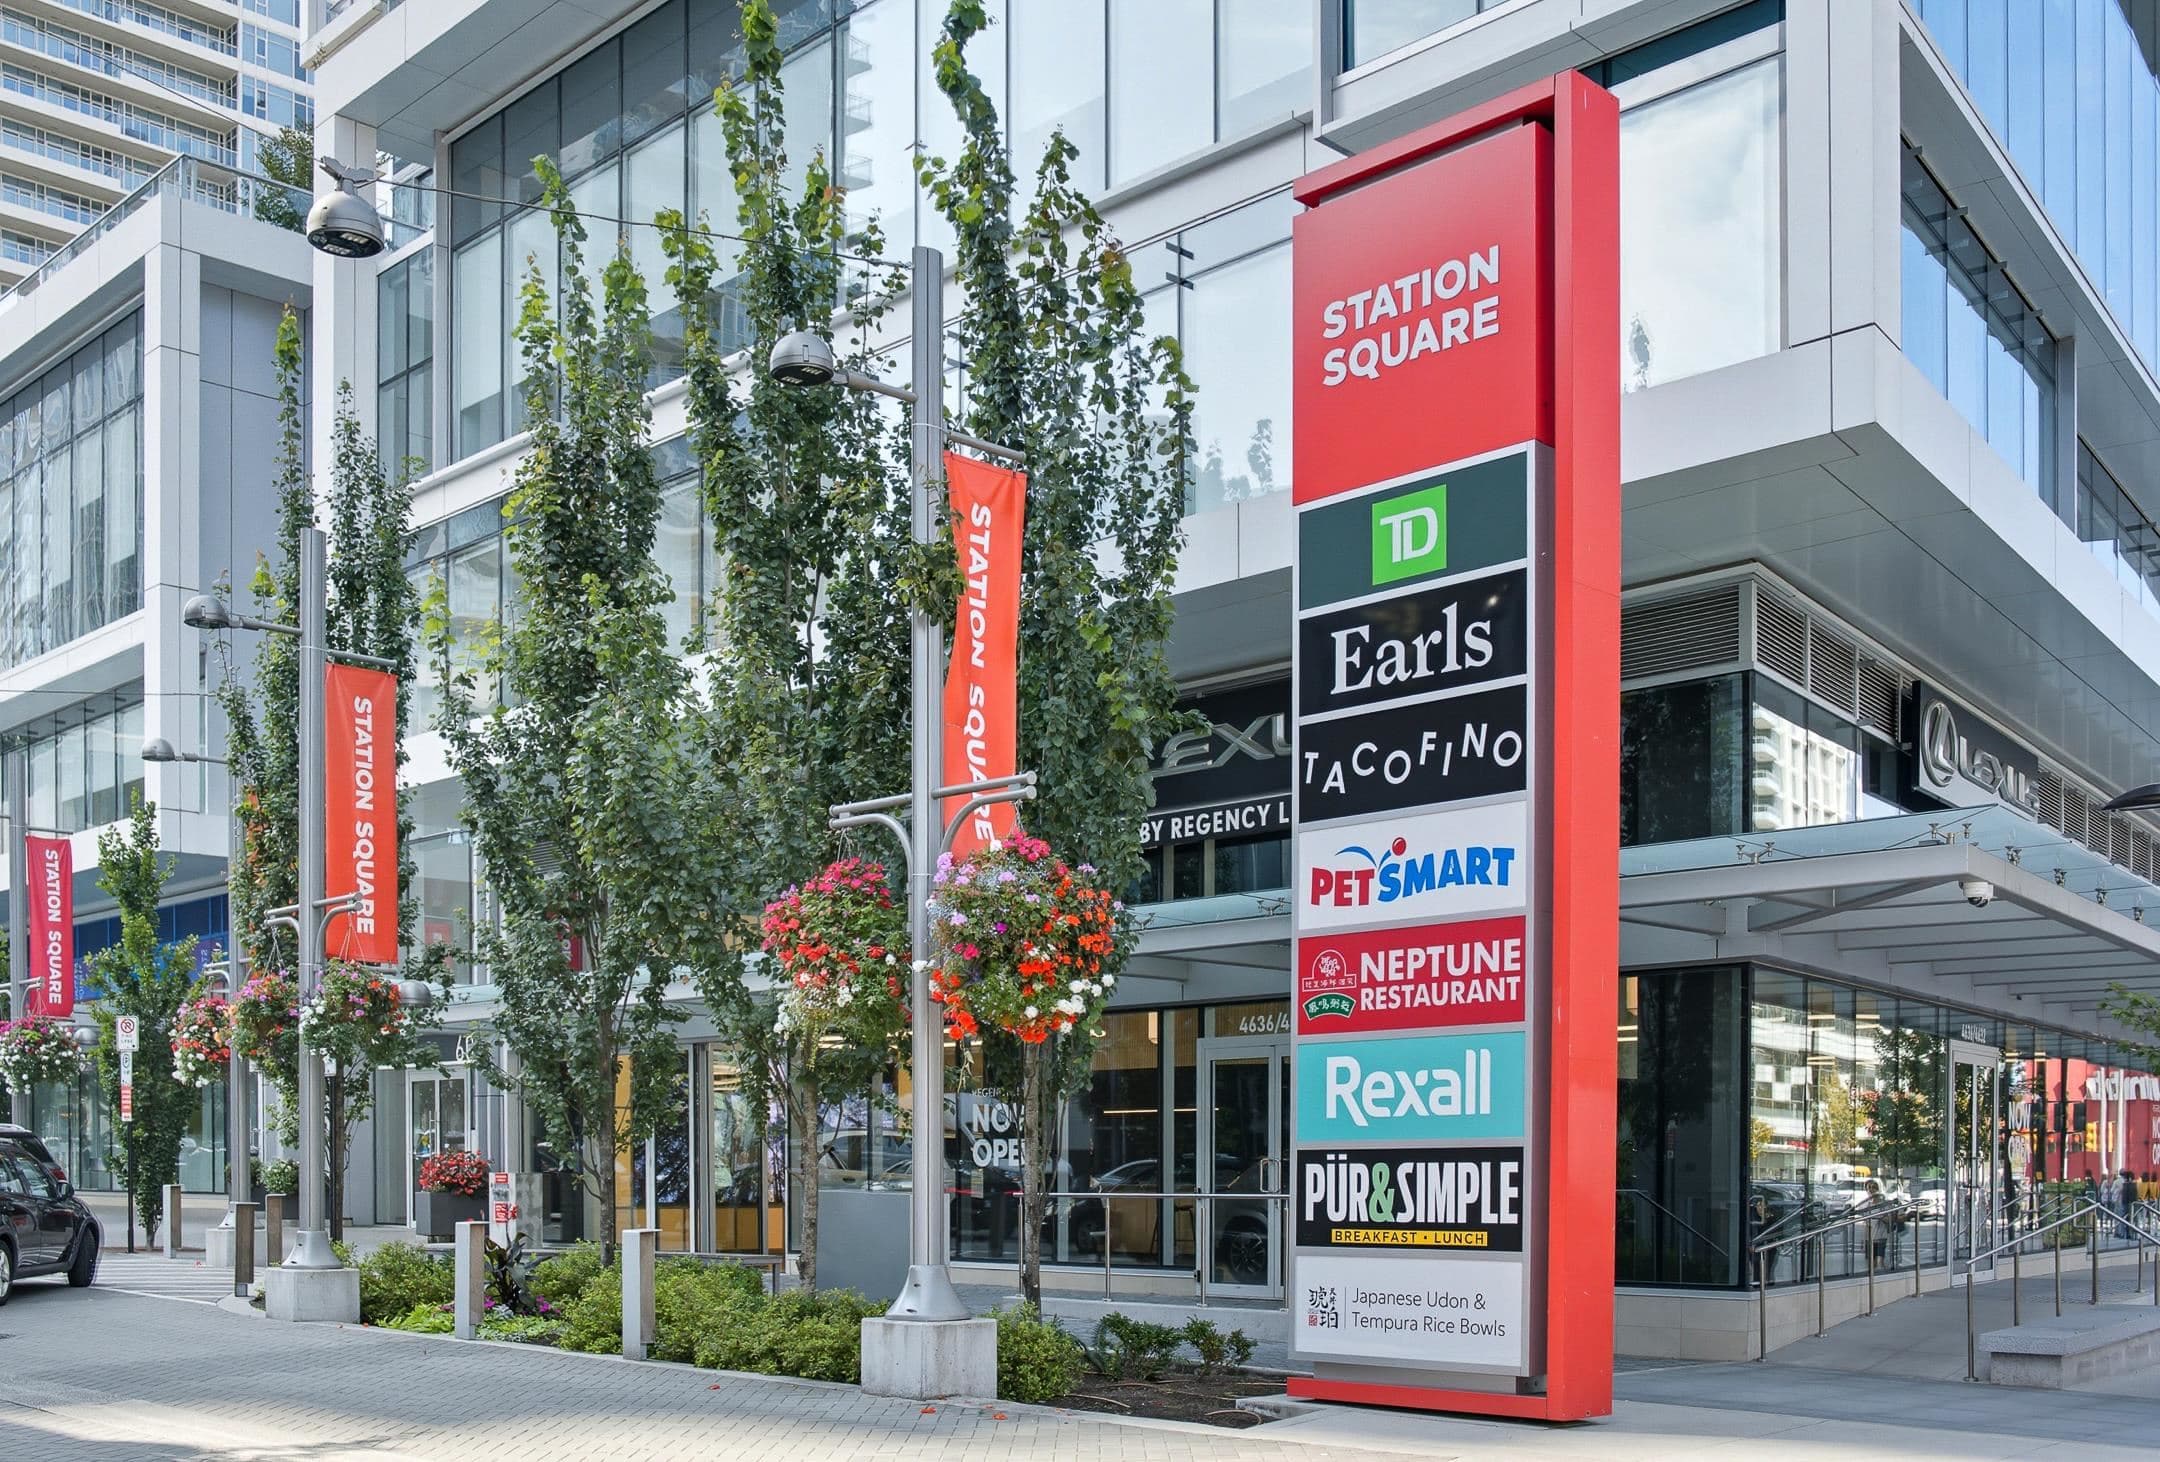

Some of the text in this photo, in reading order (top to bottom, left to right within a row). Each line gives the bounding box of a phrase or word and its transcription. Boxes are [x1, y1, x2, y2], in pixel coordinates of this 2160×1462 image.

[1322, 245, 1500, 339] STATION
[1322, 295, 1500, 386] SQUARE
[1379, 506, 1438, 563] TD
[967, 501, 992, 669] STATION
[1330, 602, 1494, 695] Earls
[1304, 723, 1522, 794] TACOFINO
[354, 695, 376, 936] STATION SQUARE
[1139, 819, 1164, 844] BY
[1170, 803, 1271, 840] REGENCY
[1310, 846, 1515, 907] PETSMART
[45, 849, 62, 1005] STATION SQUARE
[1360, 938, 1521, 984] NEPTUNE
[1239, 1012, 1290, 1034] 4636/4
[1360, 976, 1521, 1011] RESTAURANT
[1326, 1048, 1491, 1127] Rexall
[972, 1138, 1026, 1168] OPE
[1334, 1230, 1485, 1245] BREAKFAST LUNCH
[1352, 1287, 1422, 1308] Japanese
[1427, 1291, 1469, 1309] Udon
[1473, 1293, 1487, 1310] &
[1352, 1311, 1506, 1337] Tempura Rice Bowls
